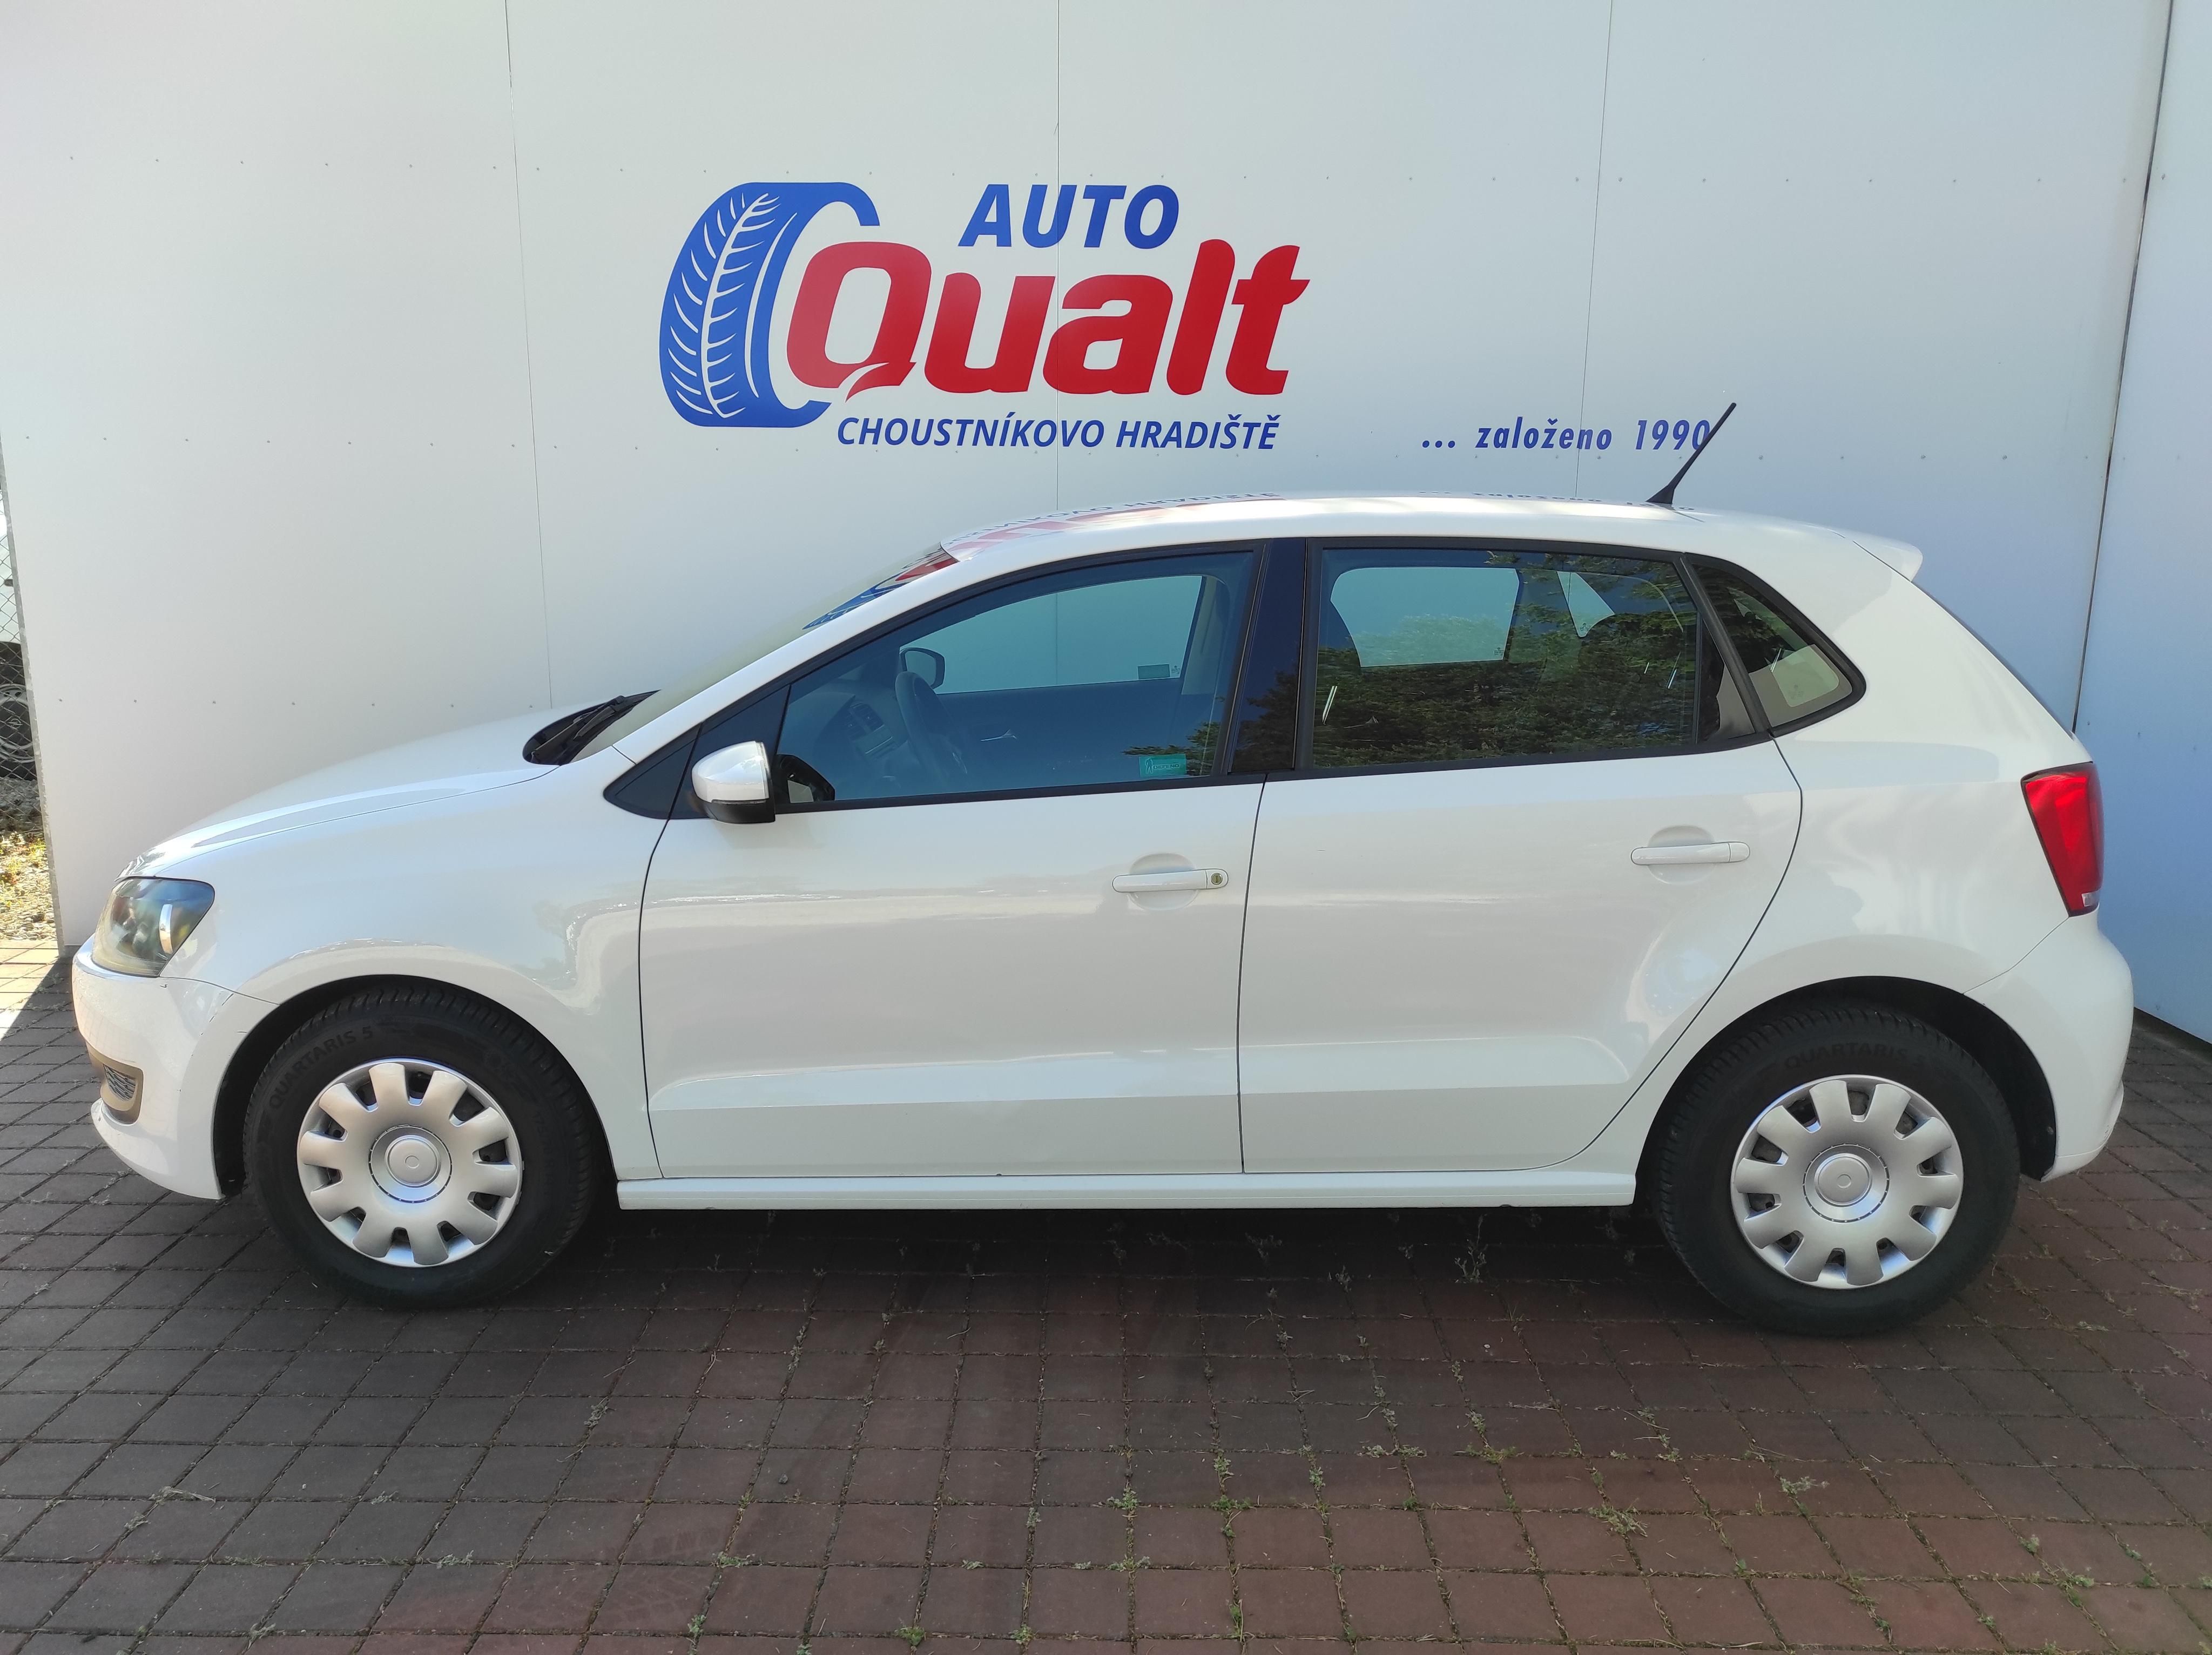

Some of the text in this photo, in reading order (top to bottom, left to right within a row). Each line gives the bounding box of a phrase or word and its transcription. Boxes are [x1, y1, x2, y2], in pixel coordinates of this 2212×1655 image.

[958, 184, 1179, 249] AUTO
[786, 239, 1311, 402] Qualt
[837, 411, 1280, 450] CHOUSTNÍKOVO HRADIŠTĚ
[1475, 416, 1613, 450] založeno
[1635, 420, 1710, 450] 1990
[269, 1025, 374, 1109] QUARTARIS 5
[1784, 1042, 1908, 1069] QUARTARIS
